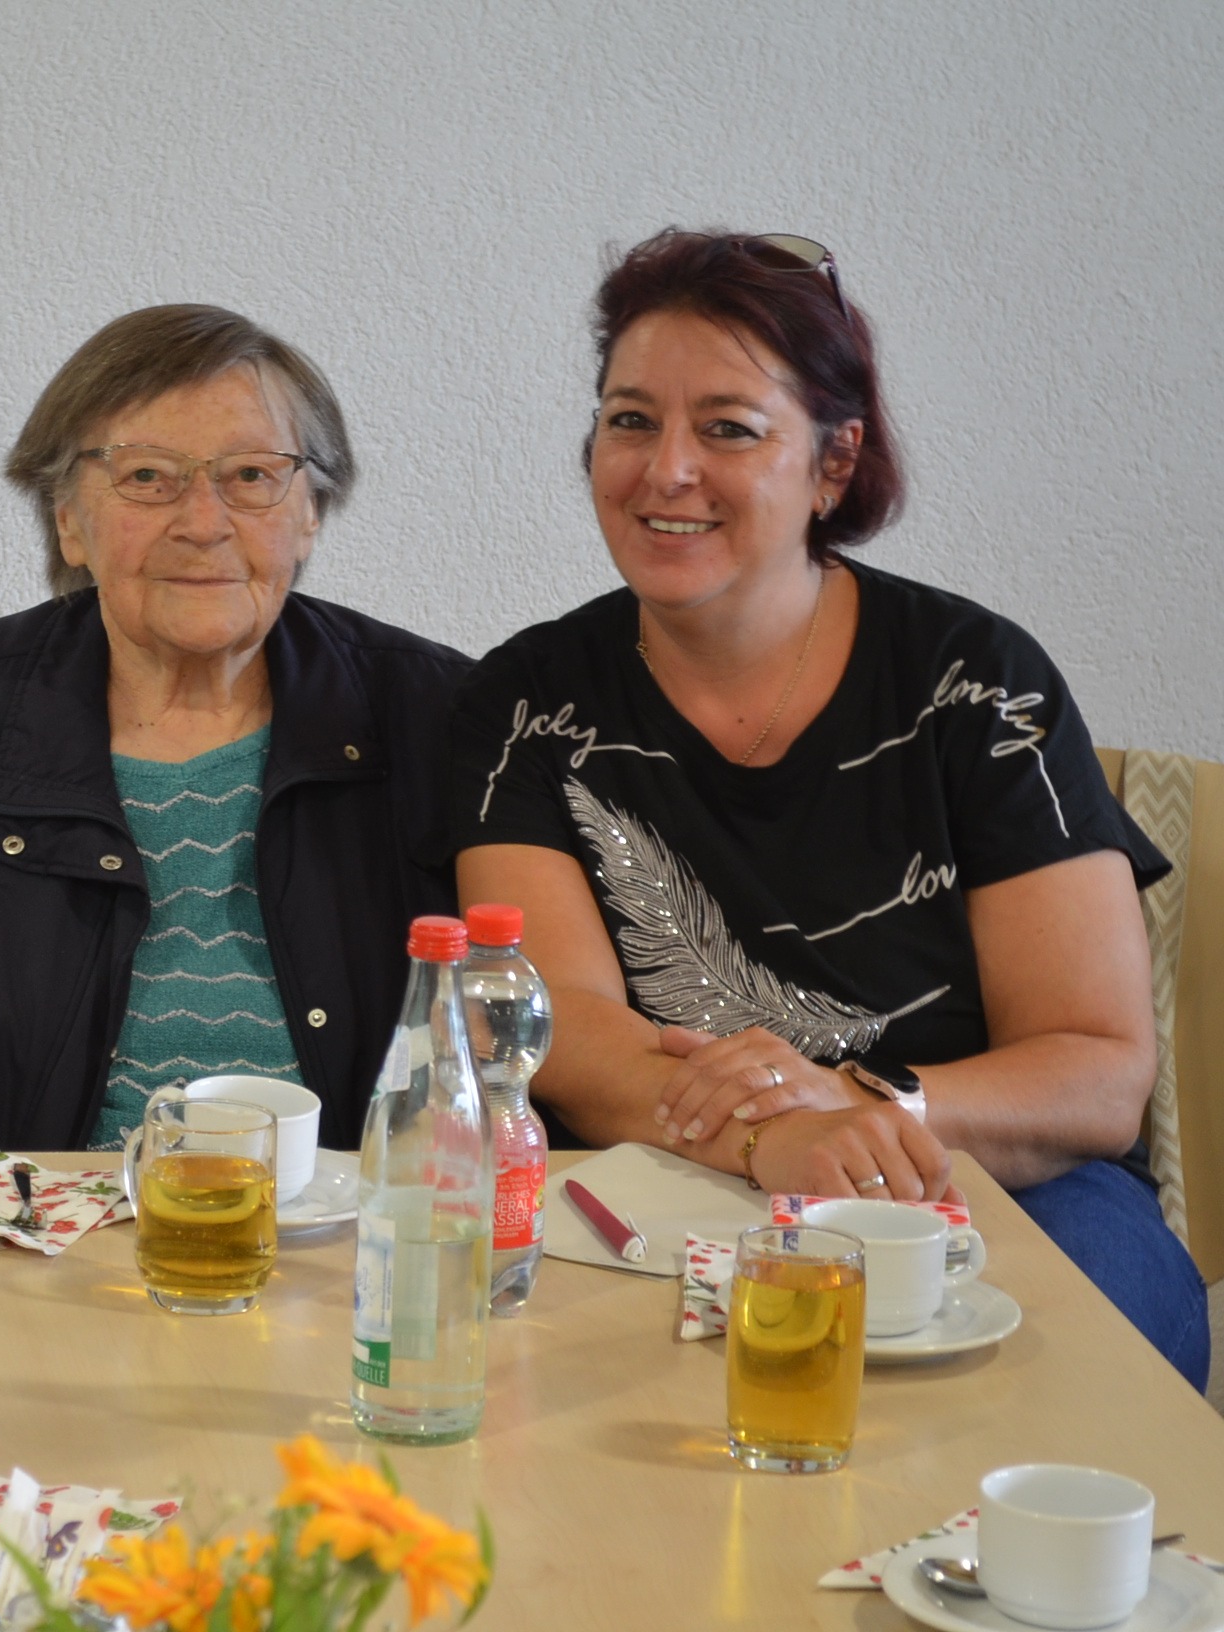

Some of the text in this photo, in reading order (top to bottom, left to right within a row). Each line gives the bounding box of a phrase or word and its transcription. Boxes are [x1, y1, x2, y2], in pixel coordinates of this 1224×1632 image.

[496, 1189, 531, 1200] RLICHES
[494, 1199, 530, 1213] NERAL
[493, 1211, 529, 1226] SSER
